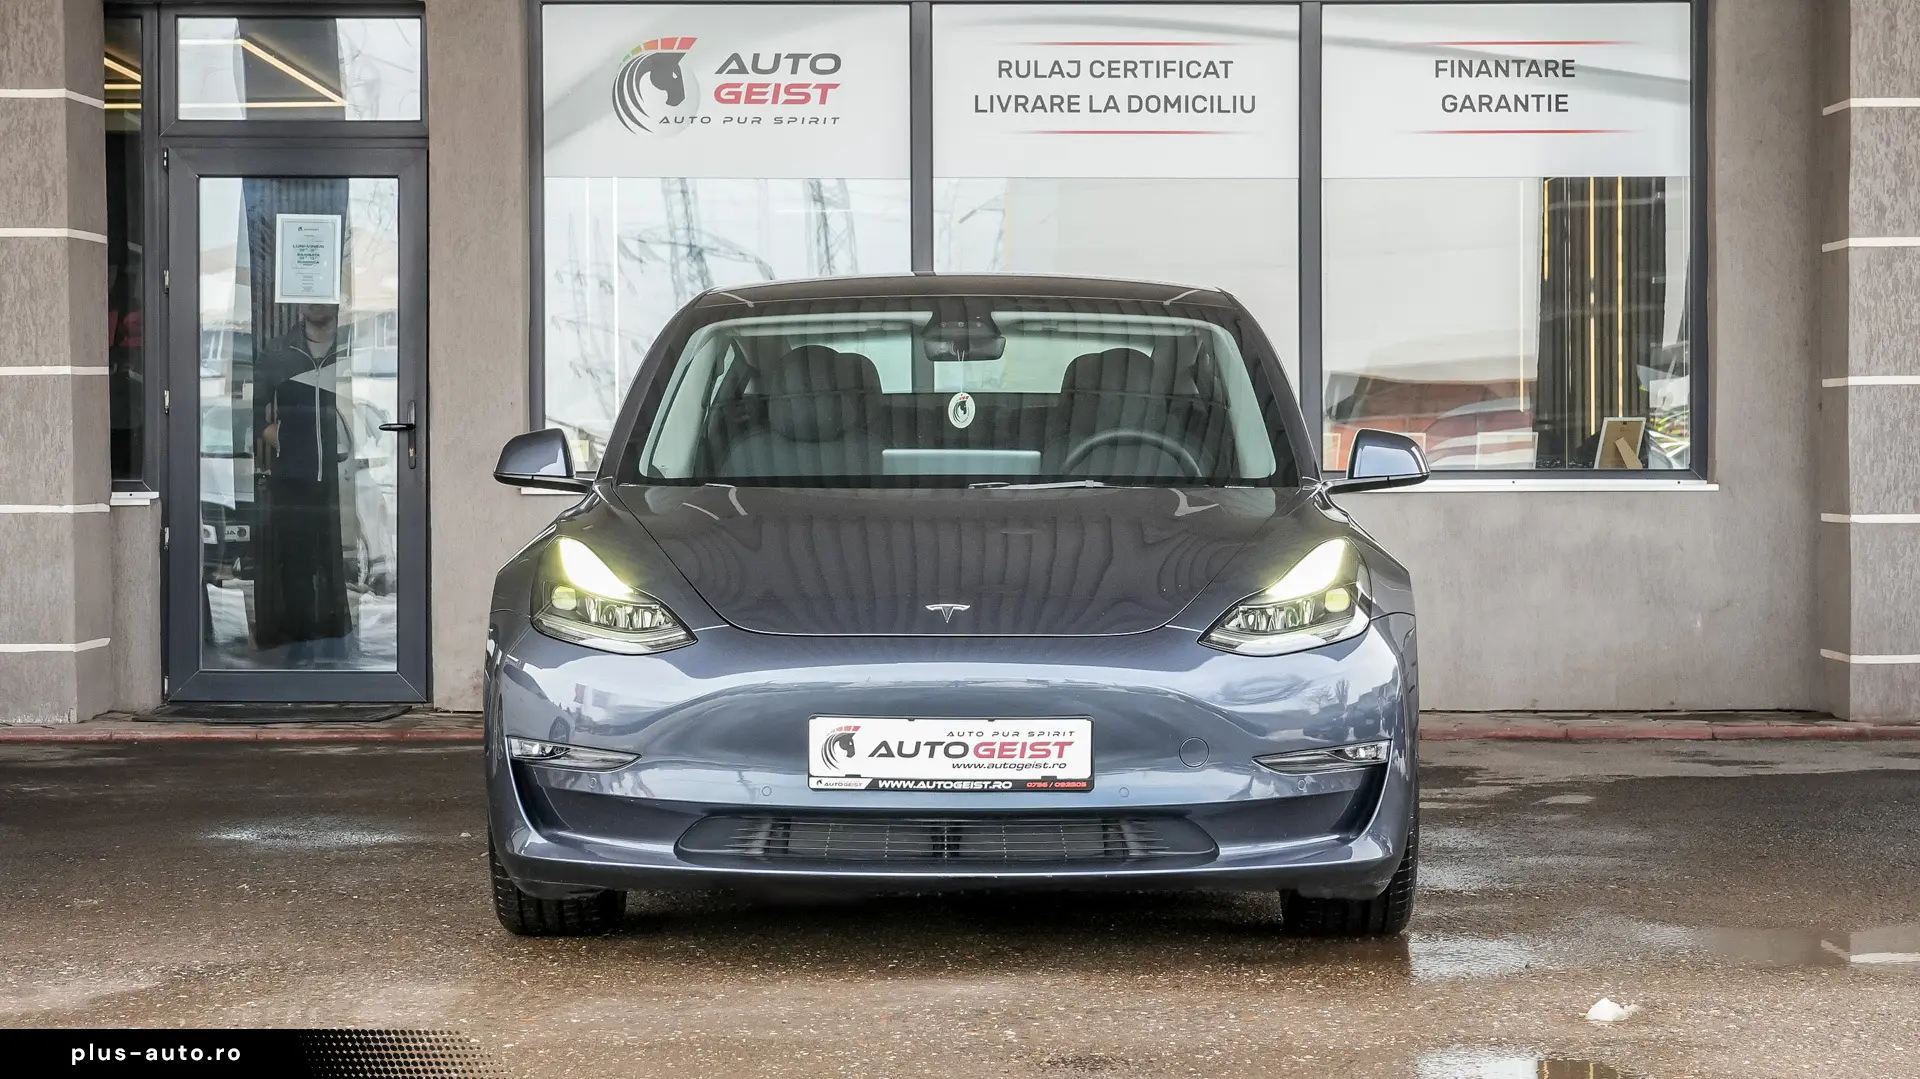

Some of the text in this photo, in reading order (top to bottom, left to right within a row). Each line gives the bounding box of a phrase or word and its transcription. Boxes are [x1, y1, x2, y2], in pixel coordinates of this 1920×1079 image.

[714, 52, 842, 76] AUTO
[997, 59, 1234, 79] RULAJ CERTIFICAT
[1434, 59, 1576, 78] FINANTARE
[713, 82, 841, 105] GEIST
[1441, 93, 1569, 113] GARANTIE
[974, 94, 1256, 114] LIVRARE LA DOMICILIU
[658, 116, 841, 125] AUTO PUR SPIRIT
[867, 740, 1075, 759] AUTOGEIST
[951, 761, 1068, 771] www.autogeist.ro
[878, 780, 1013, 789] WWW.AUTOGEIST.RO
